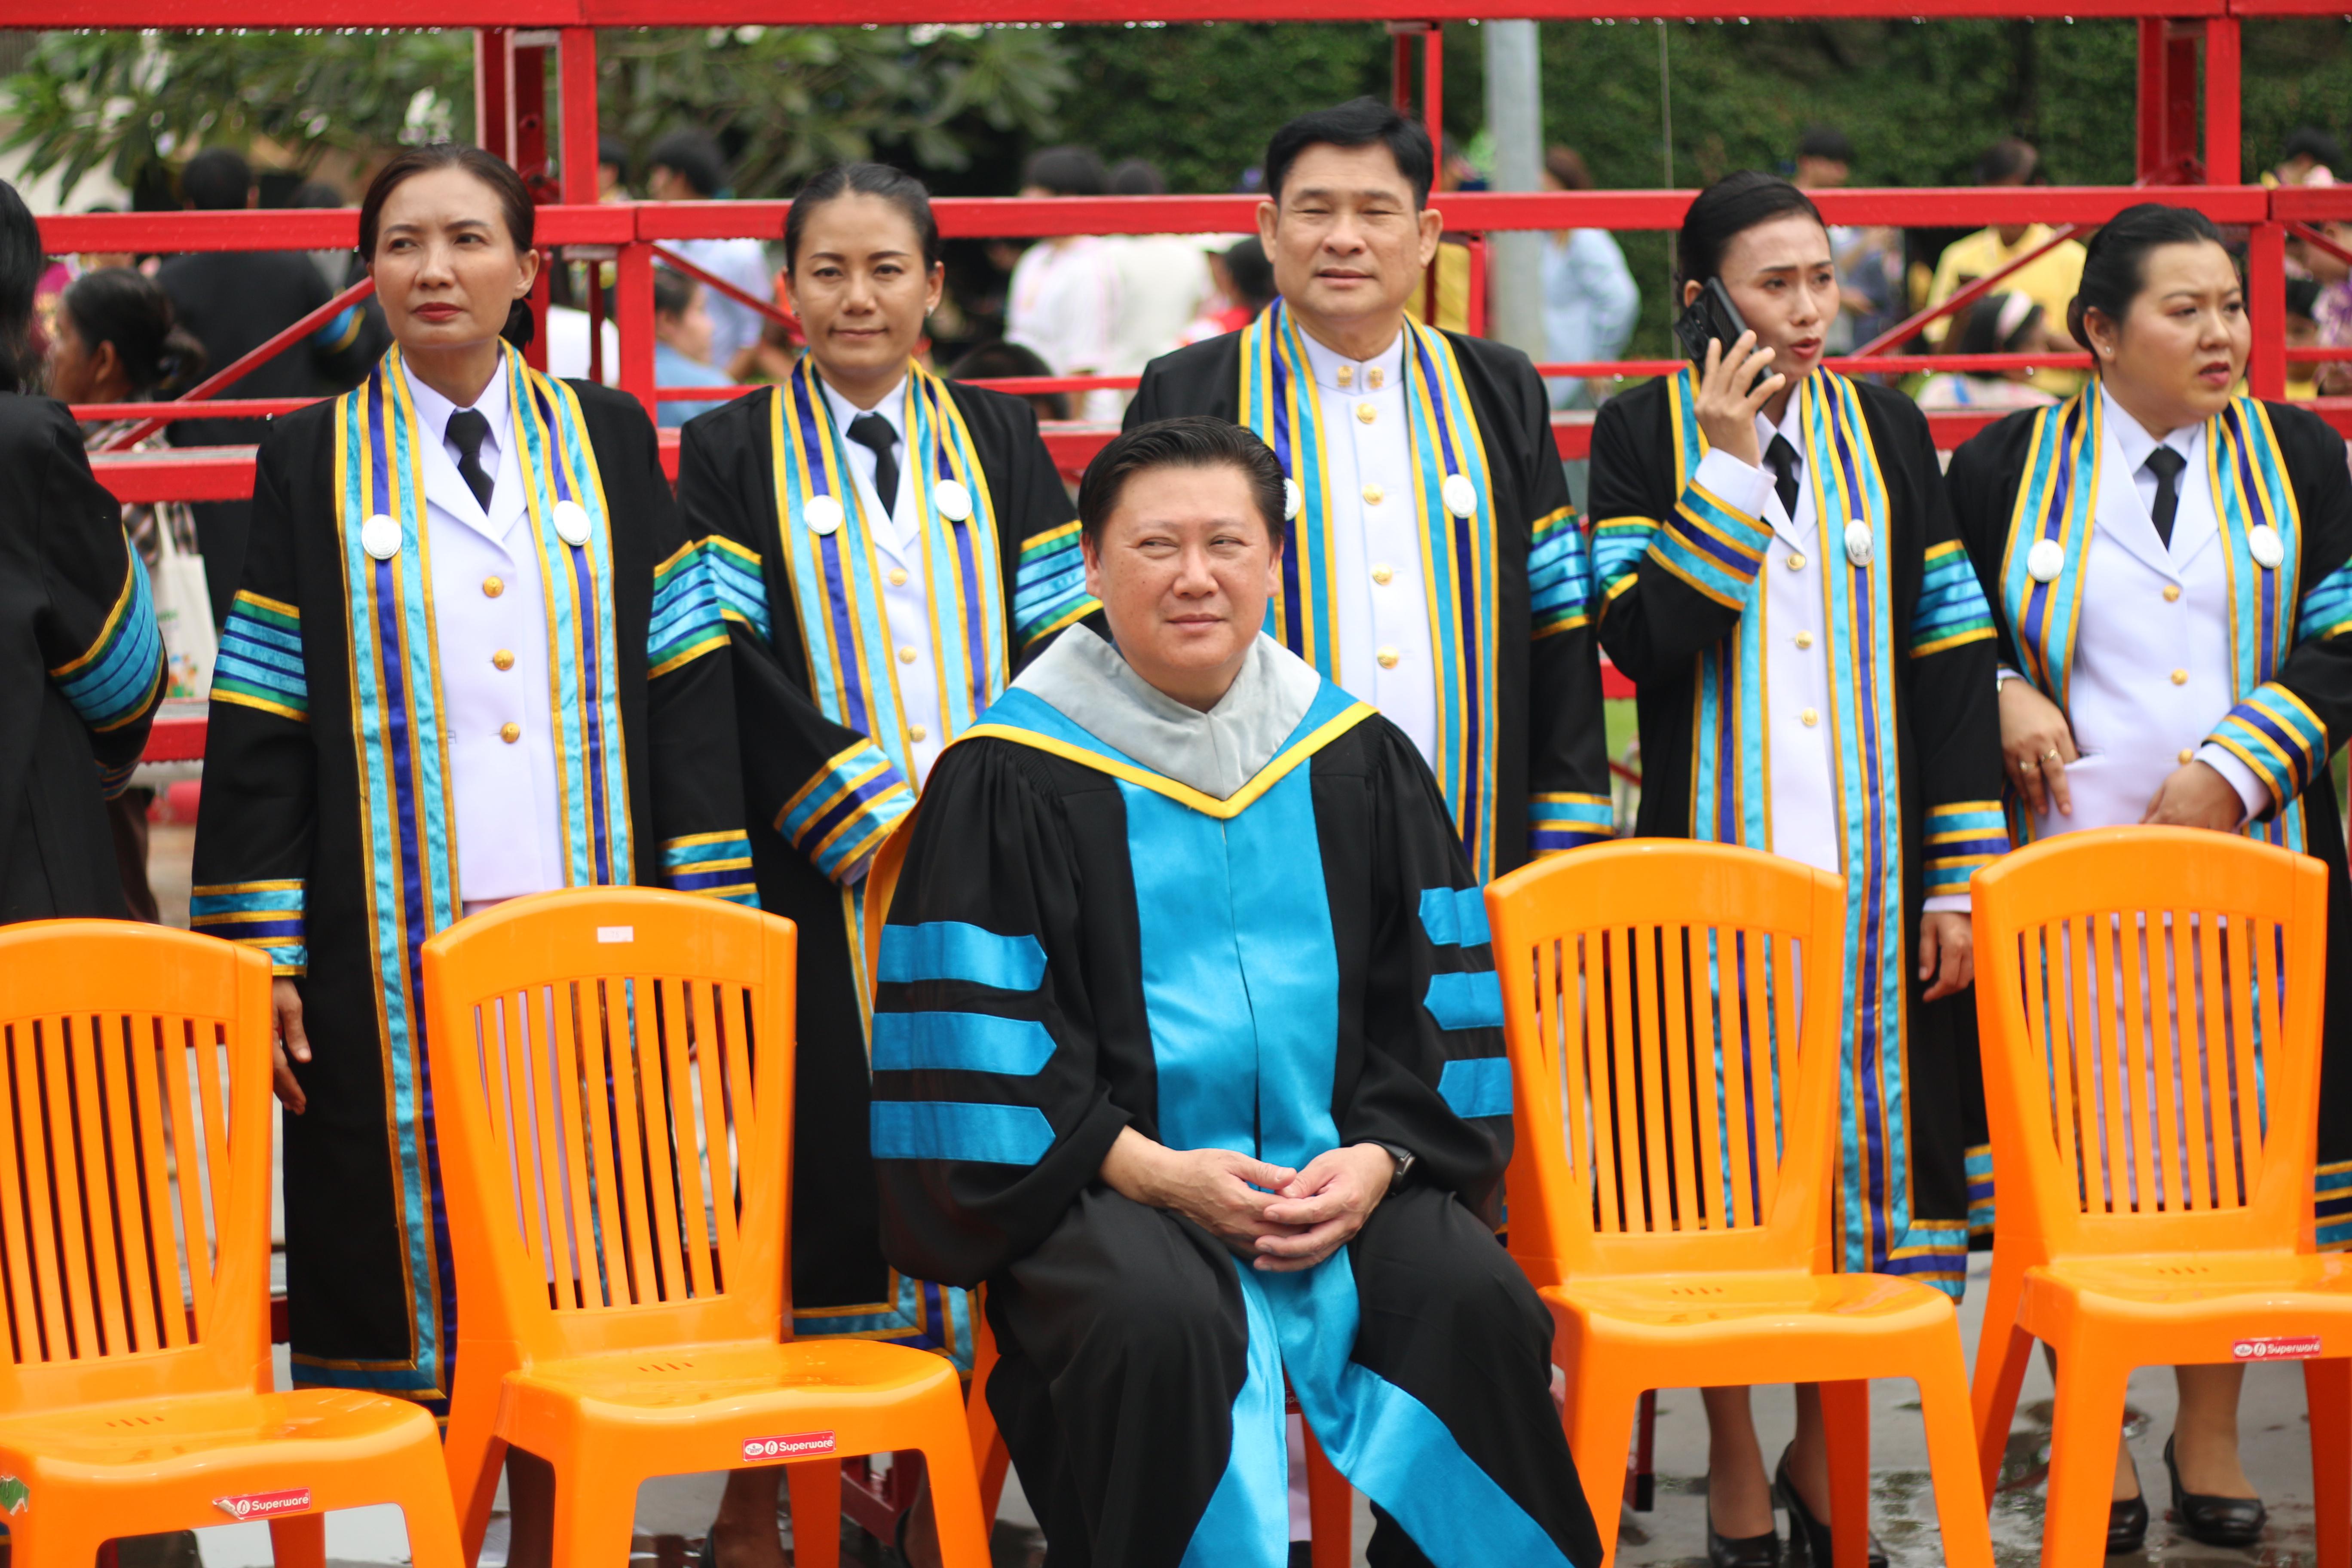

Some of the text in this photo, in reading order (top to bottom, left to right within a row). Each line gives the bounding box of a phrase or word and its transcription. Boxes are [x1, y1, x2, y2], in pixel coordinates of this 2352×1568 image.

[2268, 1343, 2320, 1355] Superware
[779, 1439, 833, 1452] Superware
[252, 1496, 309, 1511] Superware
